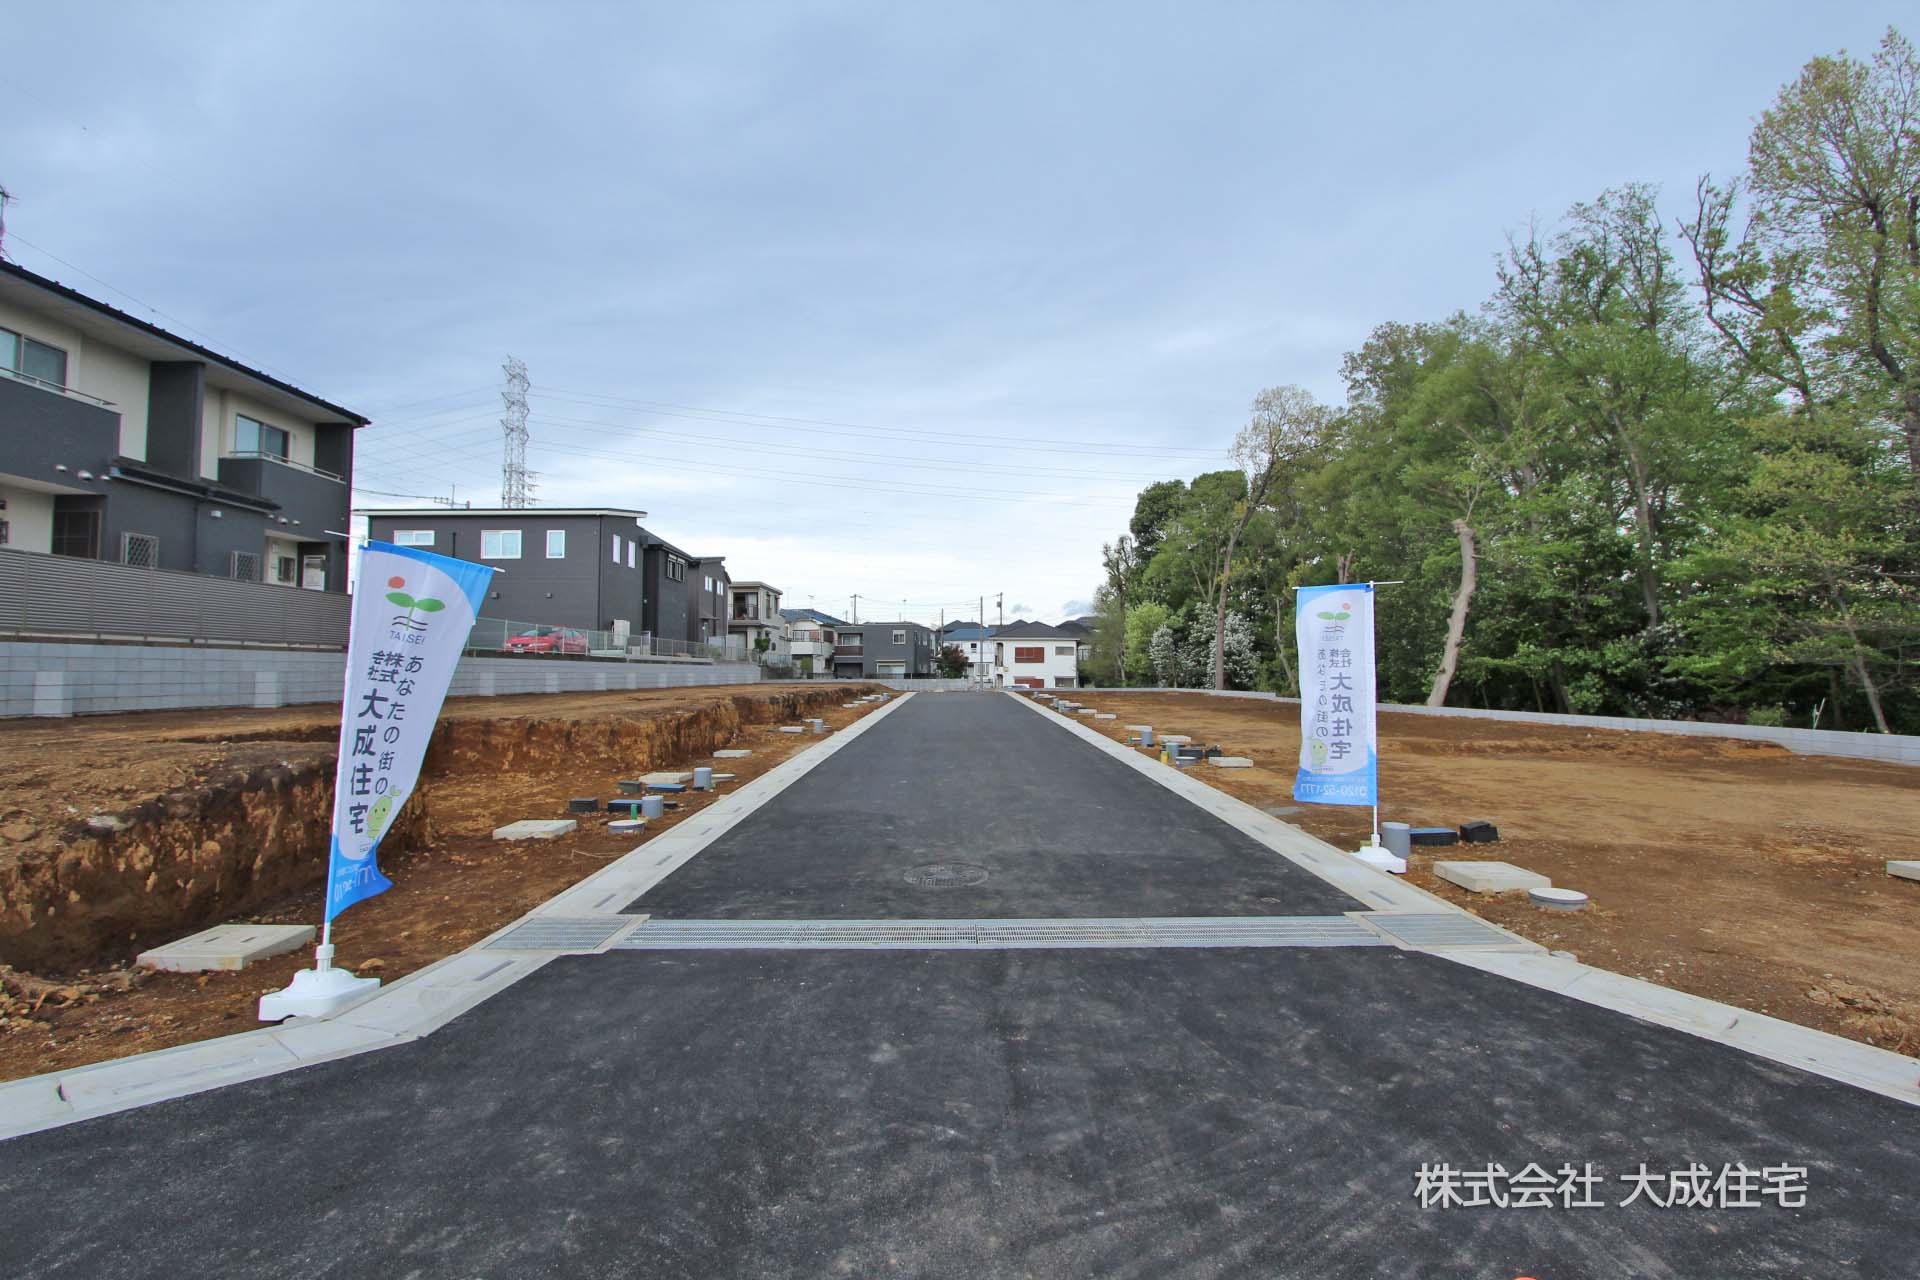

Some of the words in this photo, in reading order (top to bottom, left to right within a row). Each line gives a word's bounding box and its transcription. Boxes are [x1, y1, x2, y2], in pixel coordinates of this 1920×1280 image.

[389, 630, 426, 646] TAISEI
[349, 687, 390, 835] 大成住宅
[374, 655, 425, 796] あなたの街の
